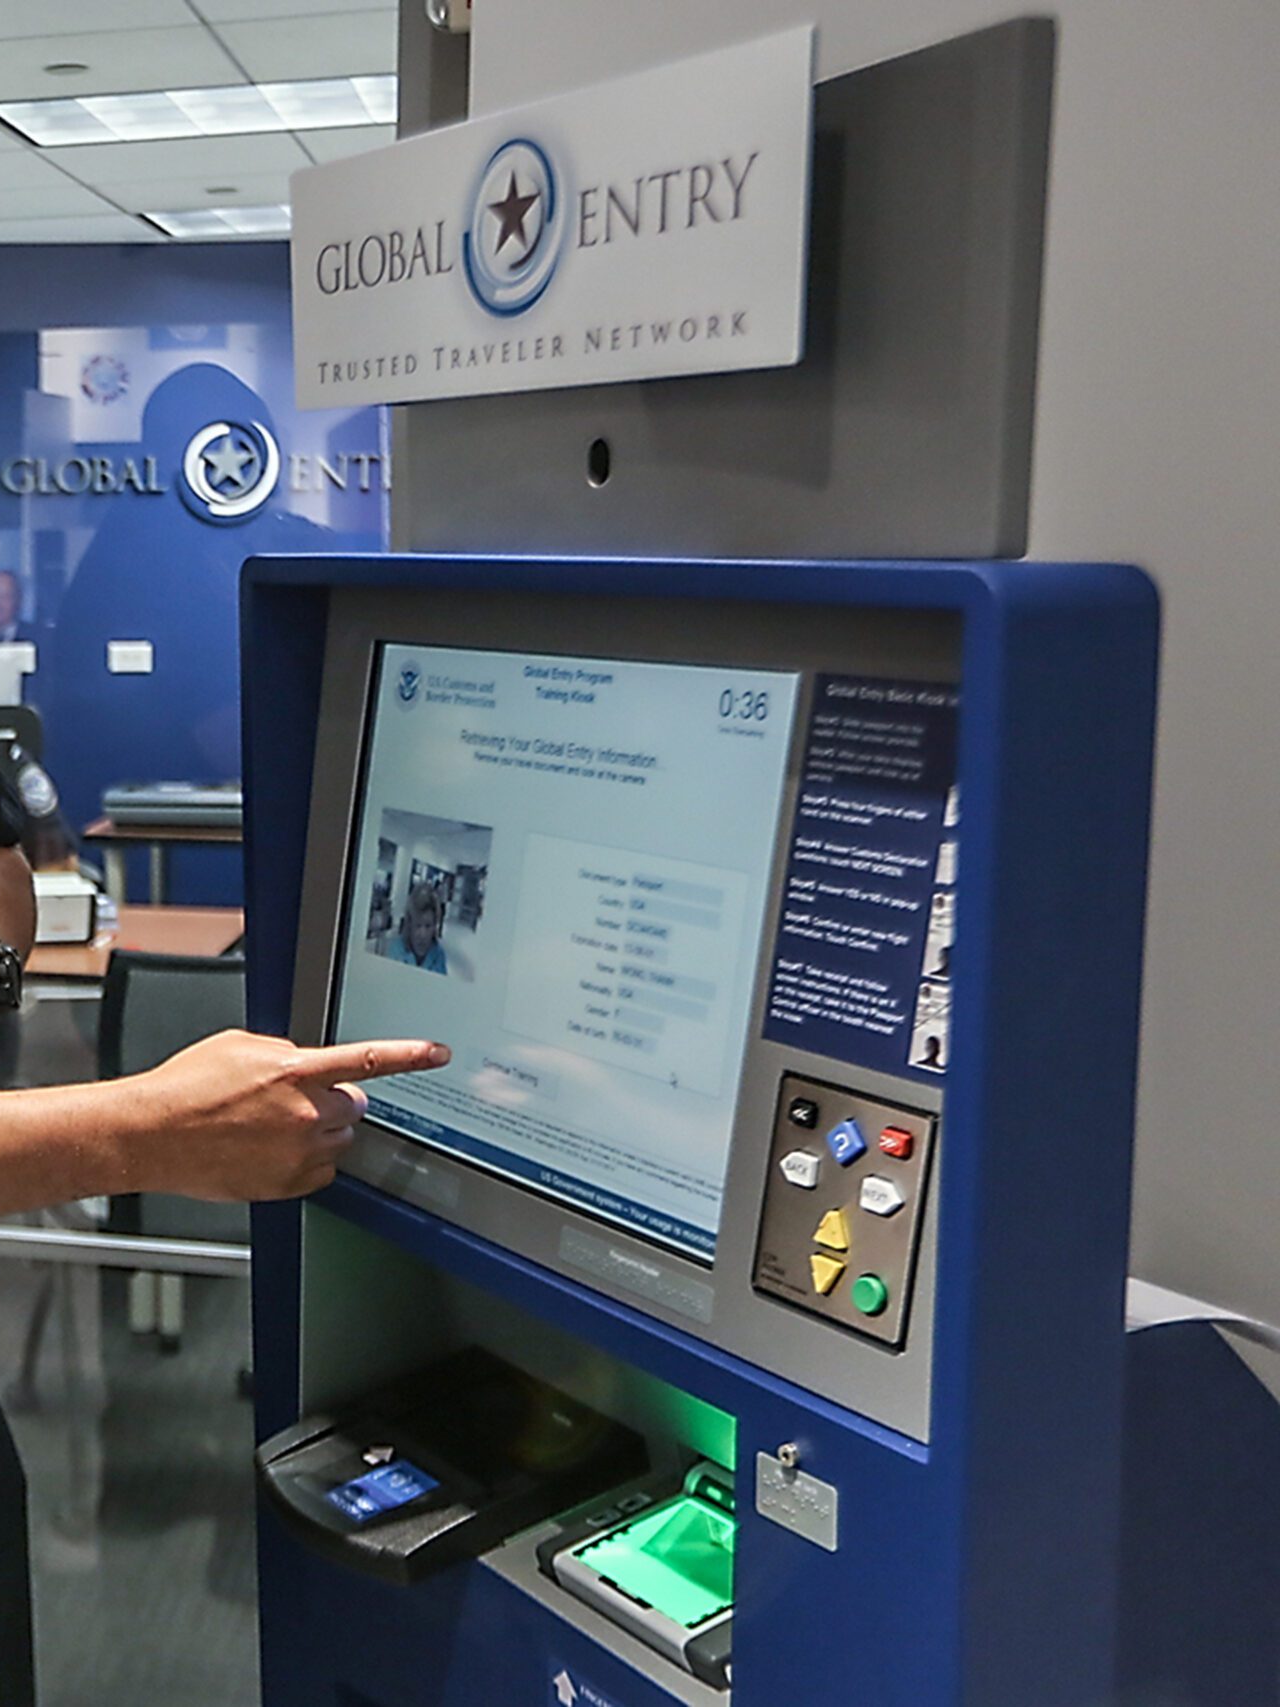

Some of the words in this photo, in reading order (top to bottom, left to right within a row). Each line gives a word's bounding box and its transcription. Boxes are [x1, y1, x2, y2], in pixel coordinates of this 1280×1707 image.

[315, 220, 453, 297] GLOBAL
[577, 152, 760, 250] ENTRY
[317, 351, 418, 385] TRUSTED
[432, 334, 566, 372] TRAVELER
[584, 311, 749, 355] NETWORK
[0, 455, 168, 496] GLOBAL
[719, 688, 768, 721] 0:36
[508, 736, 531, 752] Your
[533, 738, 565, 757] Global
[566, 742, 594, 763] Entry
